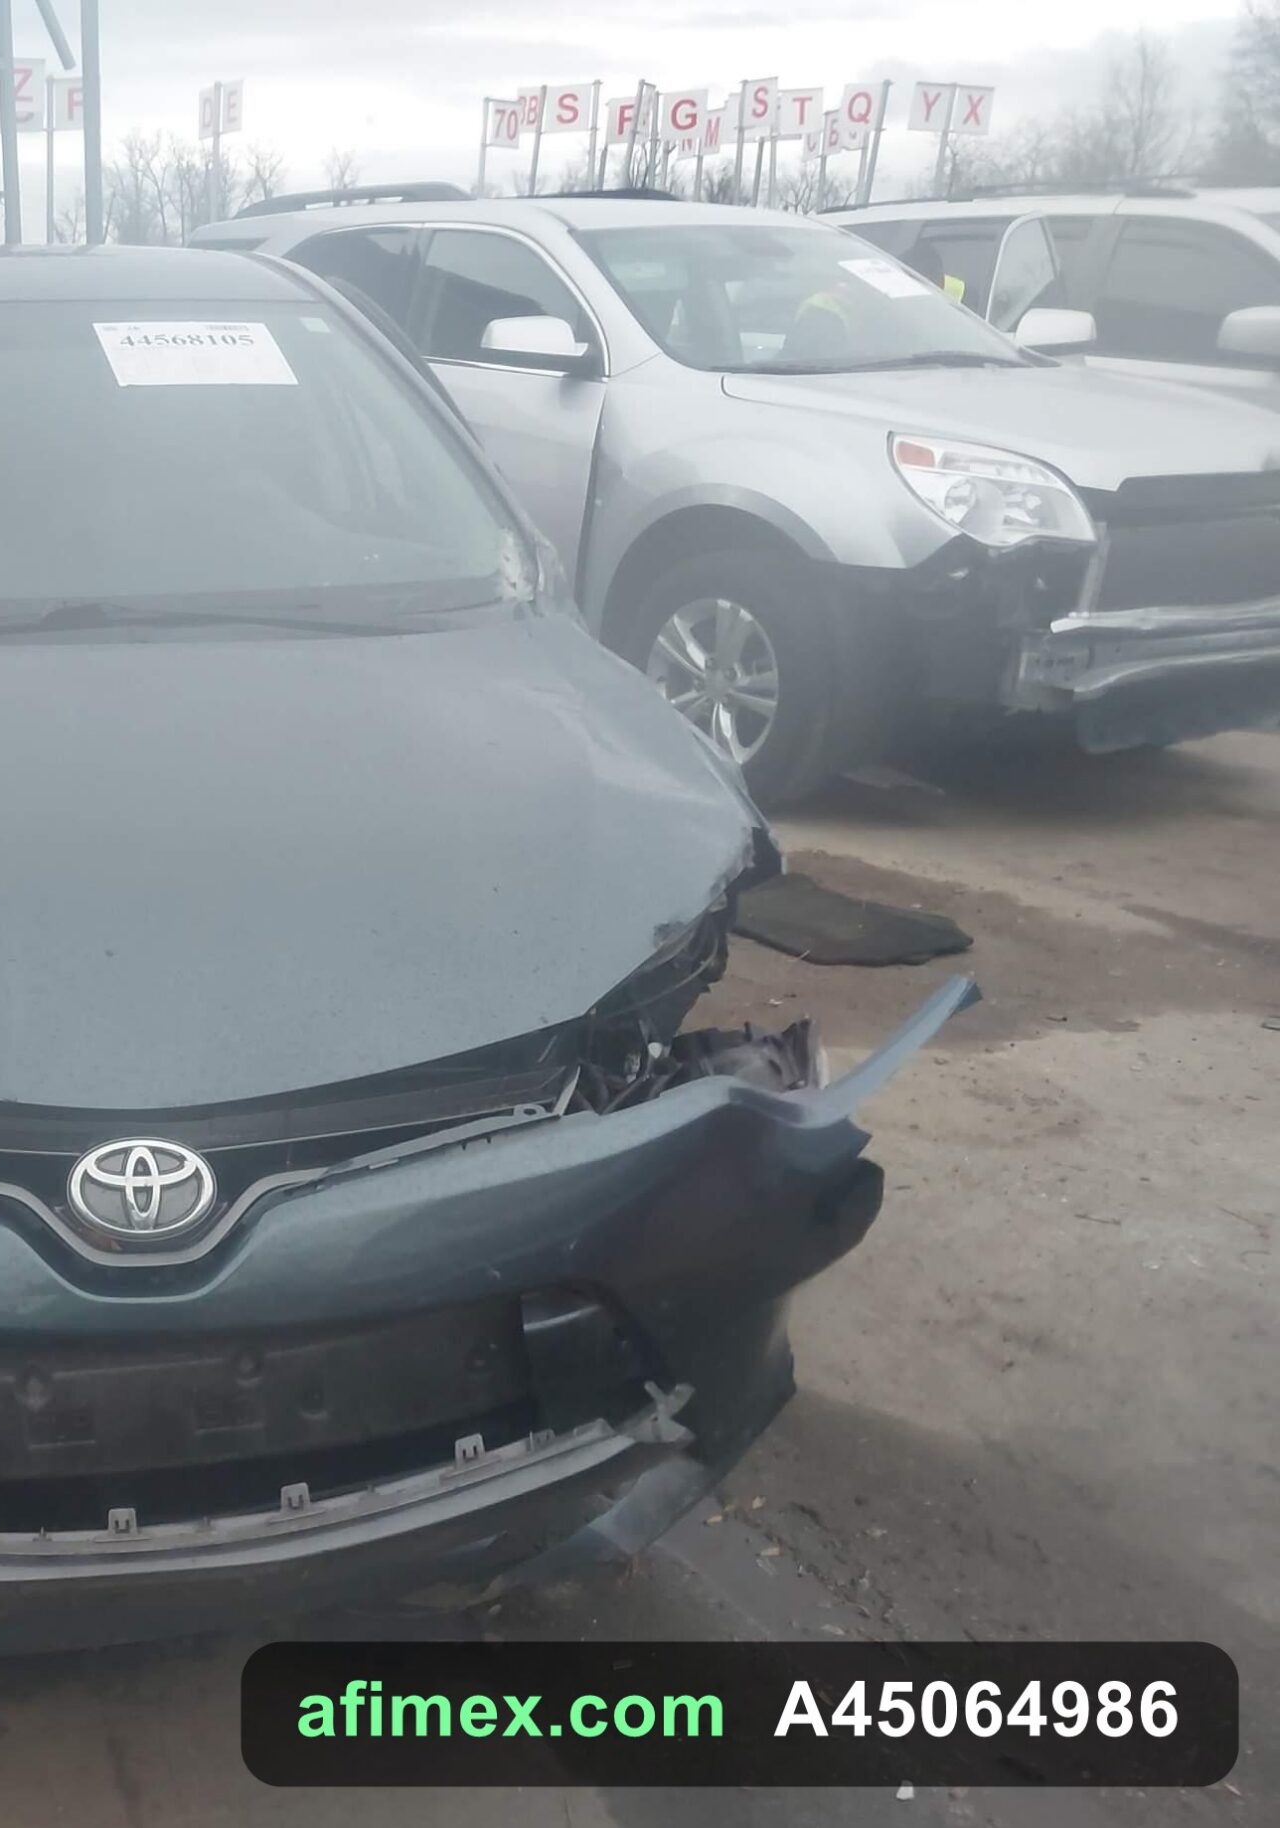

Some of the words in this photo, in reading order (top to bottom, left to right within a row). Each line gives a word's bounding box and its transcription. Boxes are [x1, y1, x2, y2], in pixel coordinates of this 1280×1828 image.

[227, 90, 238, 123] E
[556, 93, 579, 124] S
[671, 98, 697, 131] G
[752, 86, 769, 118] S
[792, 96, 813, 126] T
[847, 92, 873, 123] Q
[923, 90, 942, 123] Y
[962, 94, 985, 126] X
[494, 107, 519, 141] 70
[618, 104, 635, 136] F
[705, 116, 721, 147] M
[120, 334, 255, 347] 44568105
